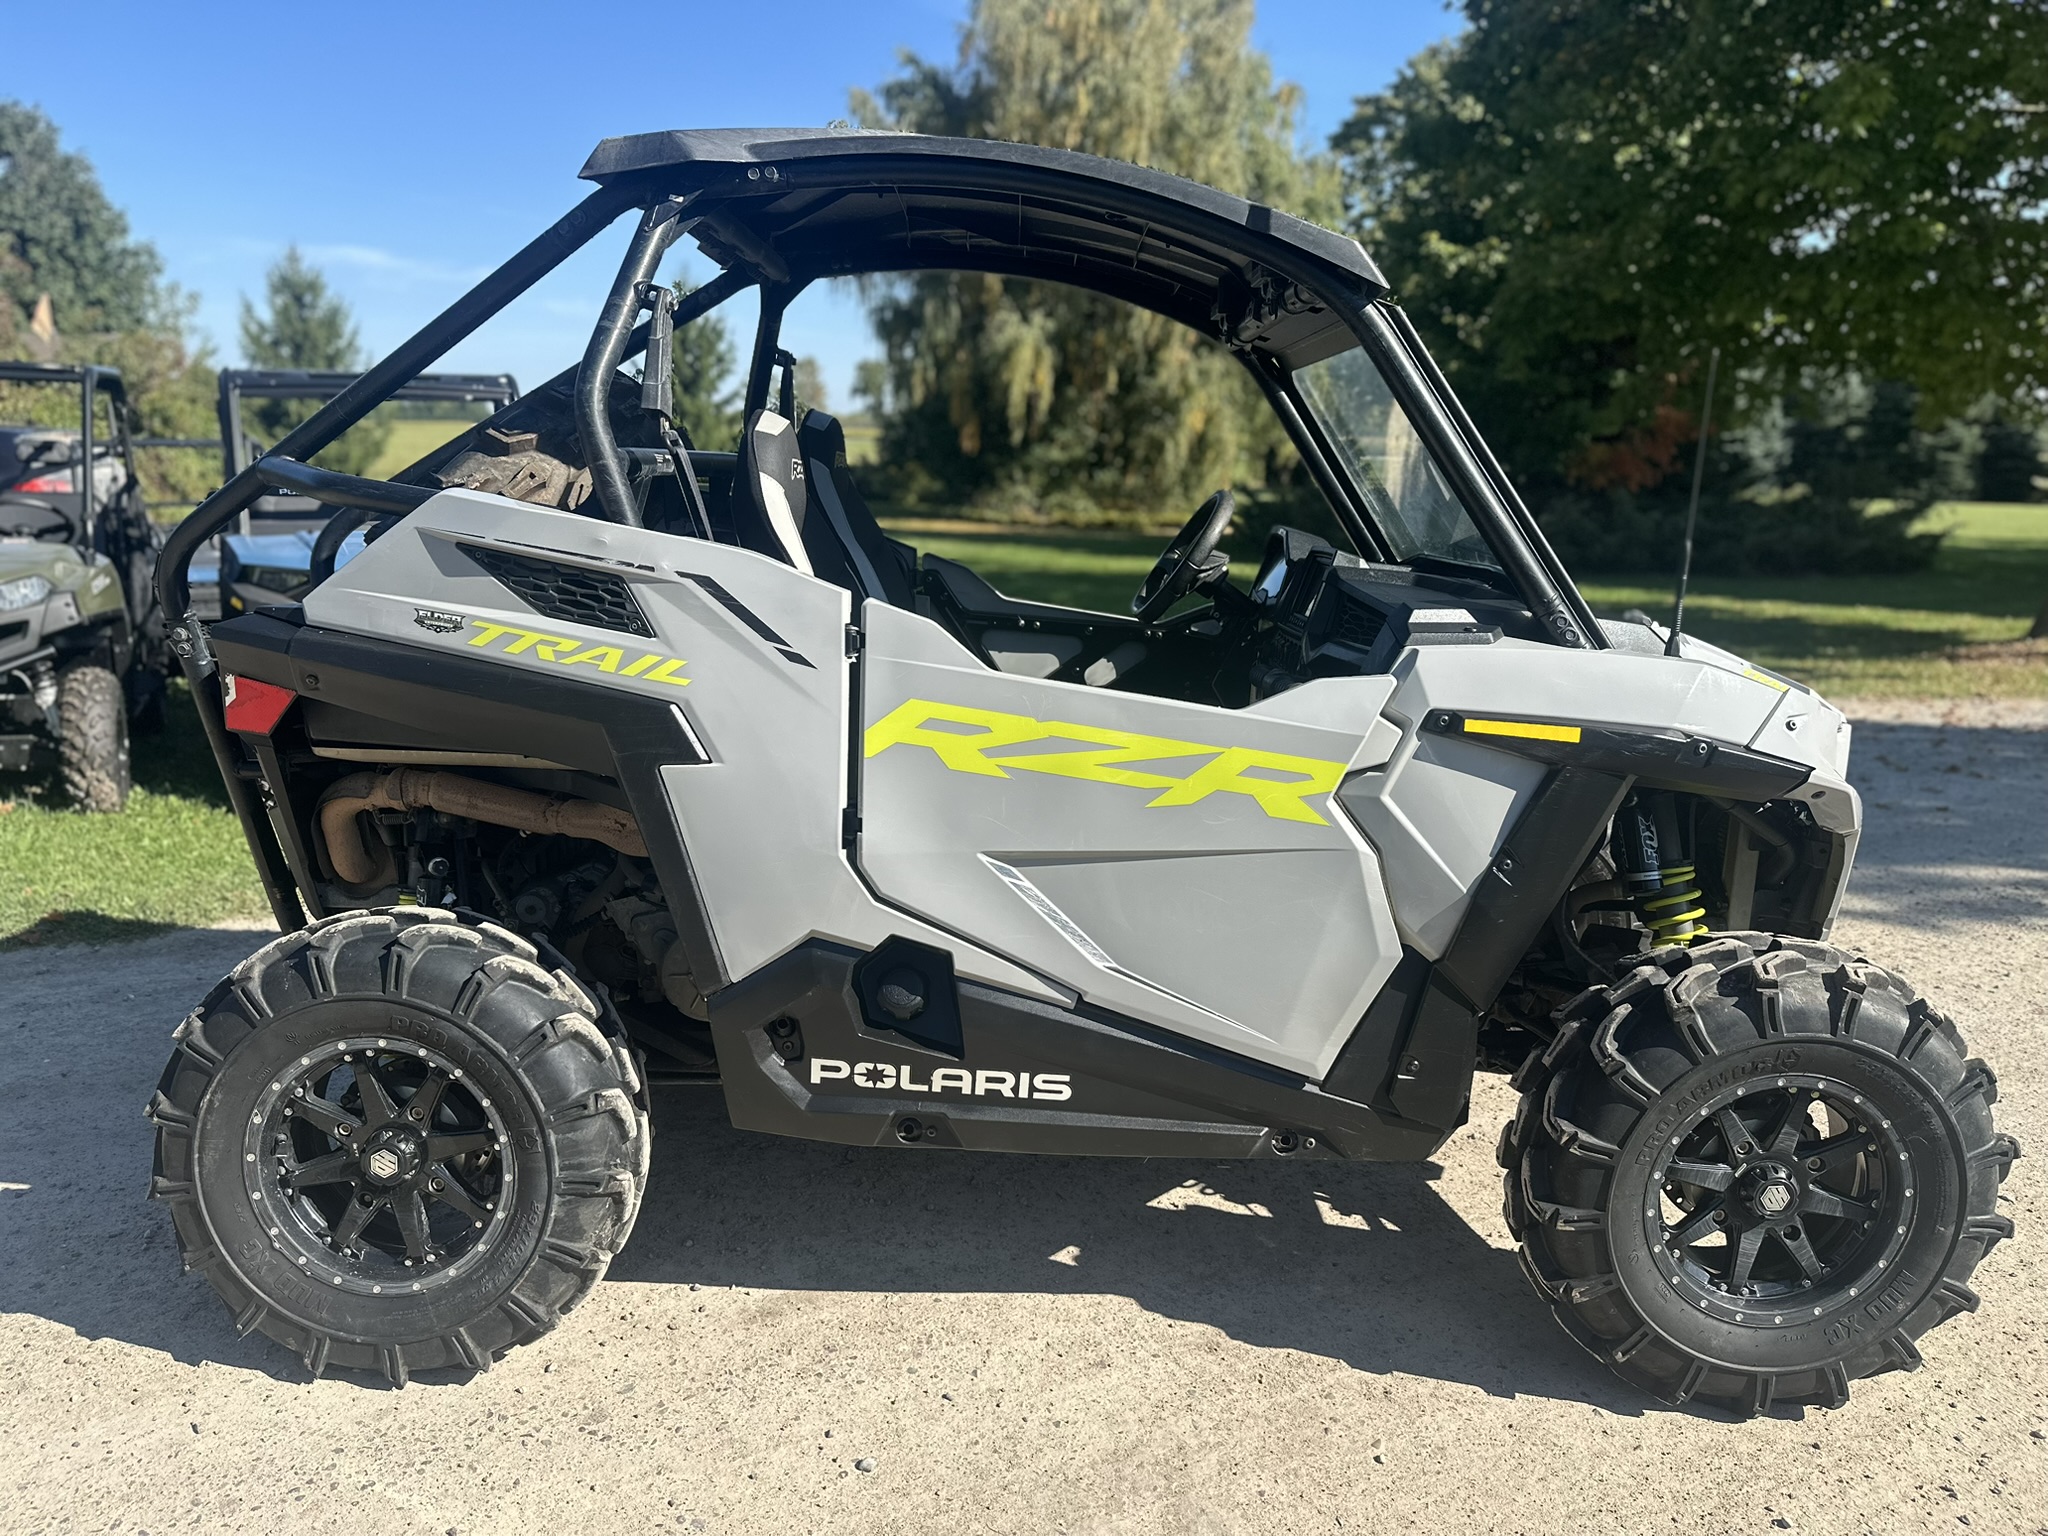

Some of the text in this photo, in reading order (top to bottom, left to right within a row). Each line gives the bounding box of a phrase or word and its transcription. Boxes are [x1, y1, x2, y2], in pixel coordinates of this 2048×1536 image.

[418, 609, 462, 626] ELDER
[467, 620, 692, 686] TRAIL
[864, 698, 1348, 827] RZR
[1637, 814, 1659, 866] FOX
[810, 1057, 1073, 1101] POLARIS
[273, 1271, 333, 1315] MUD
[1863, 1269, 1919, 1321] MUD
